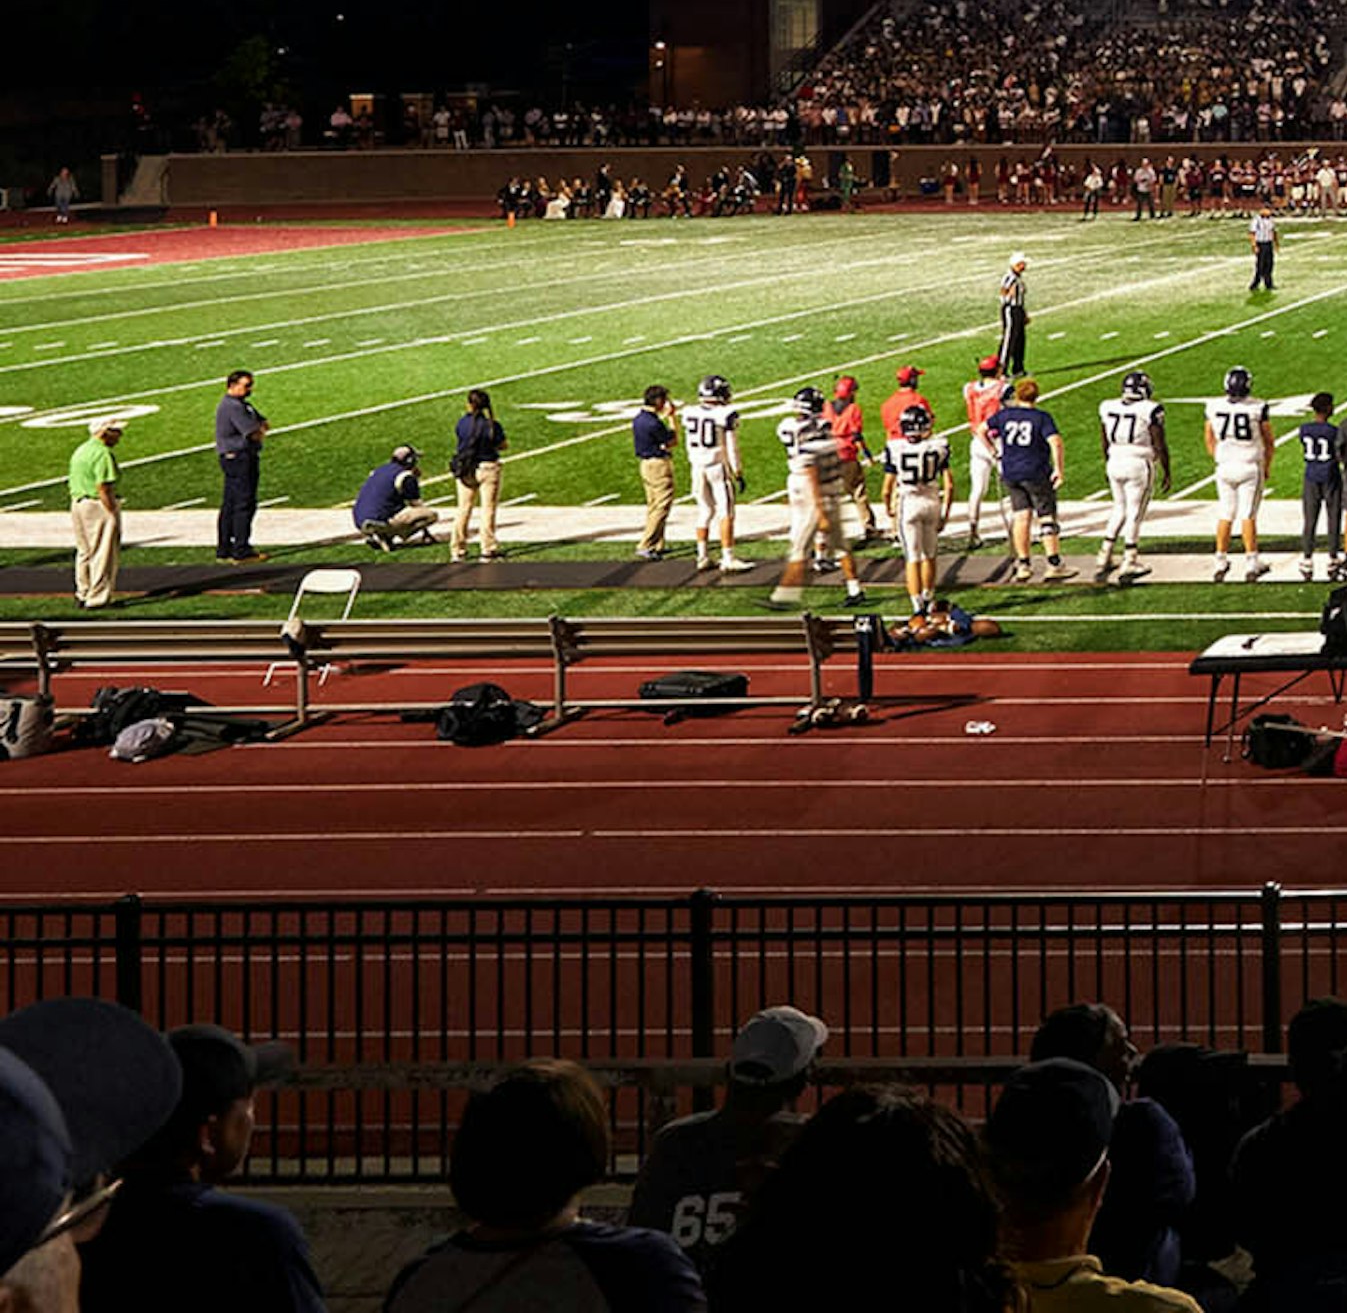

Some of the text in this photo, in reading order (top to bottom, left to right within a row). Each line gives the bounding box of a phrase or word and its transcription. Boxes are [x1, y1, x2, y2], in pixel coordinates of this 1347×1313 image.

[1107, 412, 1136, 443] 77
[1215, 412, 1252, 440] 78
[1302, 435, 1331, 462] 11
[899, 451, 939, 485] 50
[672, 1191, 743, 1248] 65
